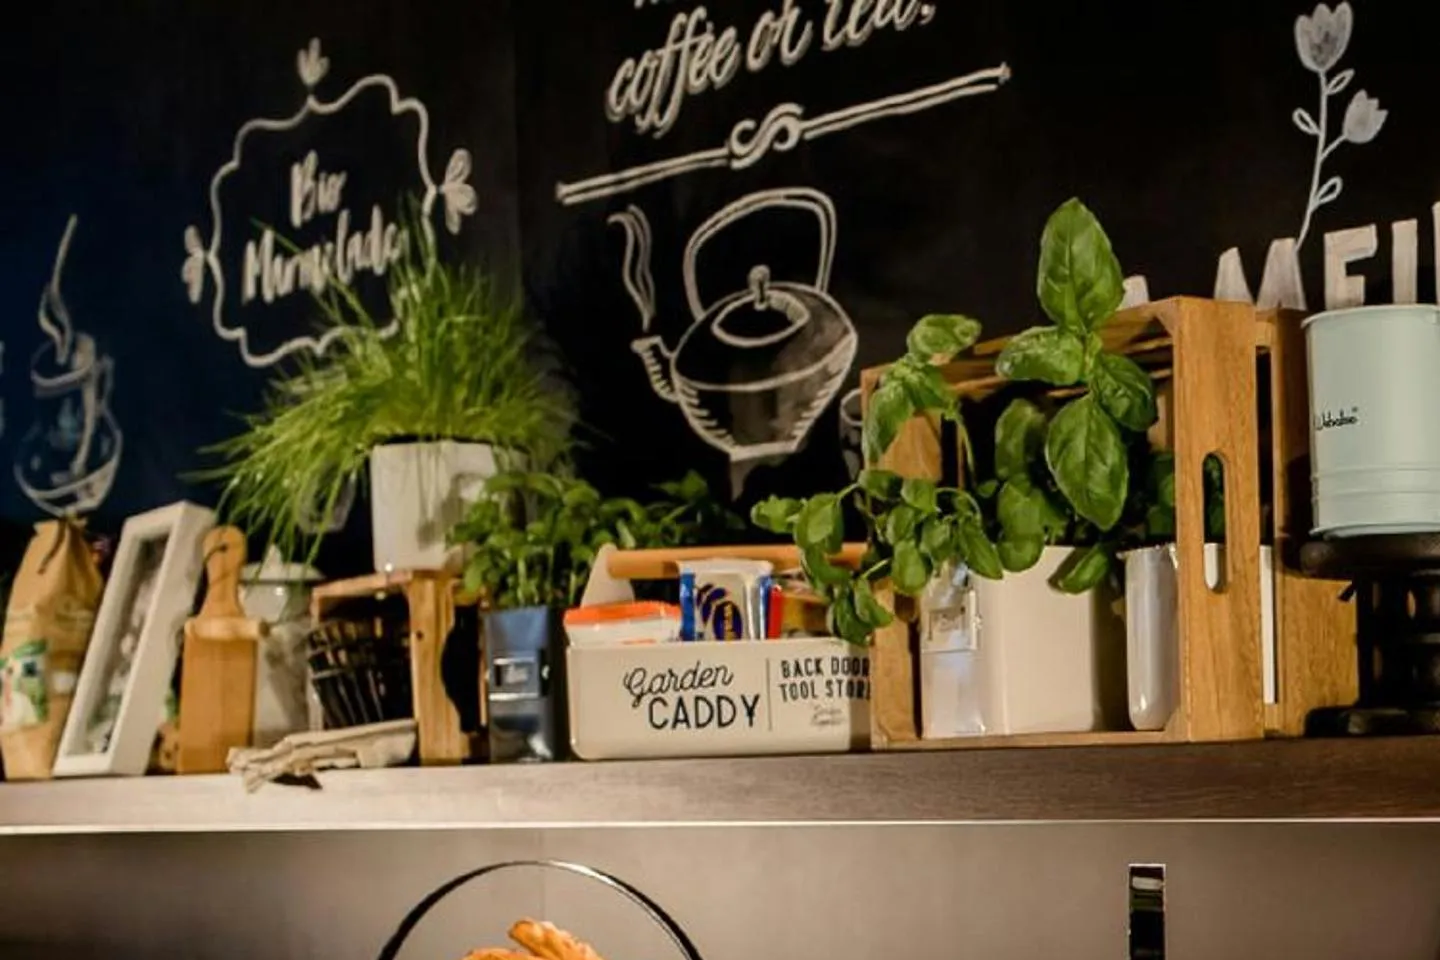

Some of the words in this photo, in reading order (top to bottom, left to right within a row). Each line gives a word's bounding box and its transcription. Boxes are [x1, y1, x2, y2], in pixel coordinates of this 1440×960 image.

[605, 5, 740, 138] coffee
[623, 660, 734, 708] Garden
[780, 657, 824, 679] BACK
[830, 655, 870, 677] DOOR
[778, 680, 818, 702] TOOL
[648, 693, 761, 731] CADDY
